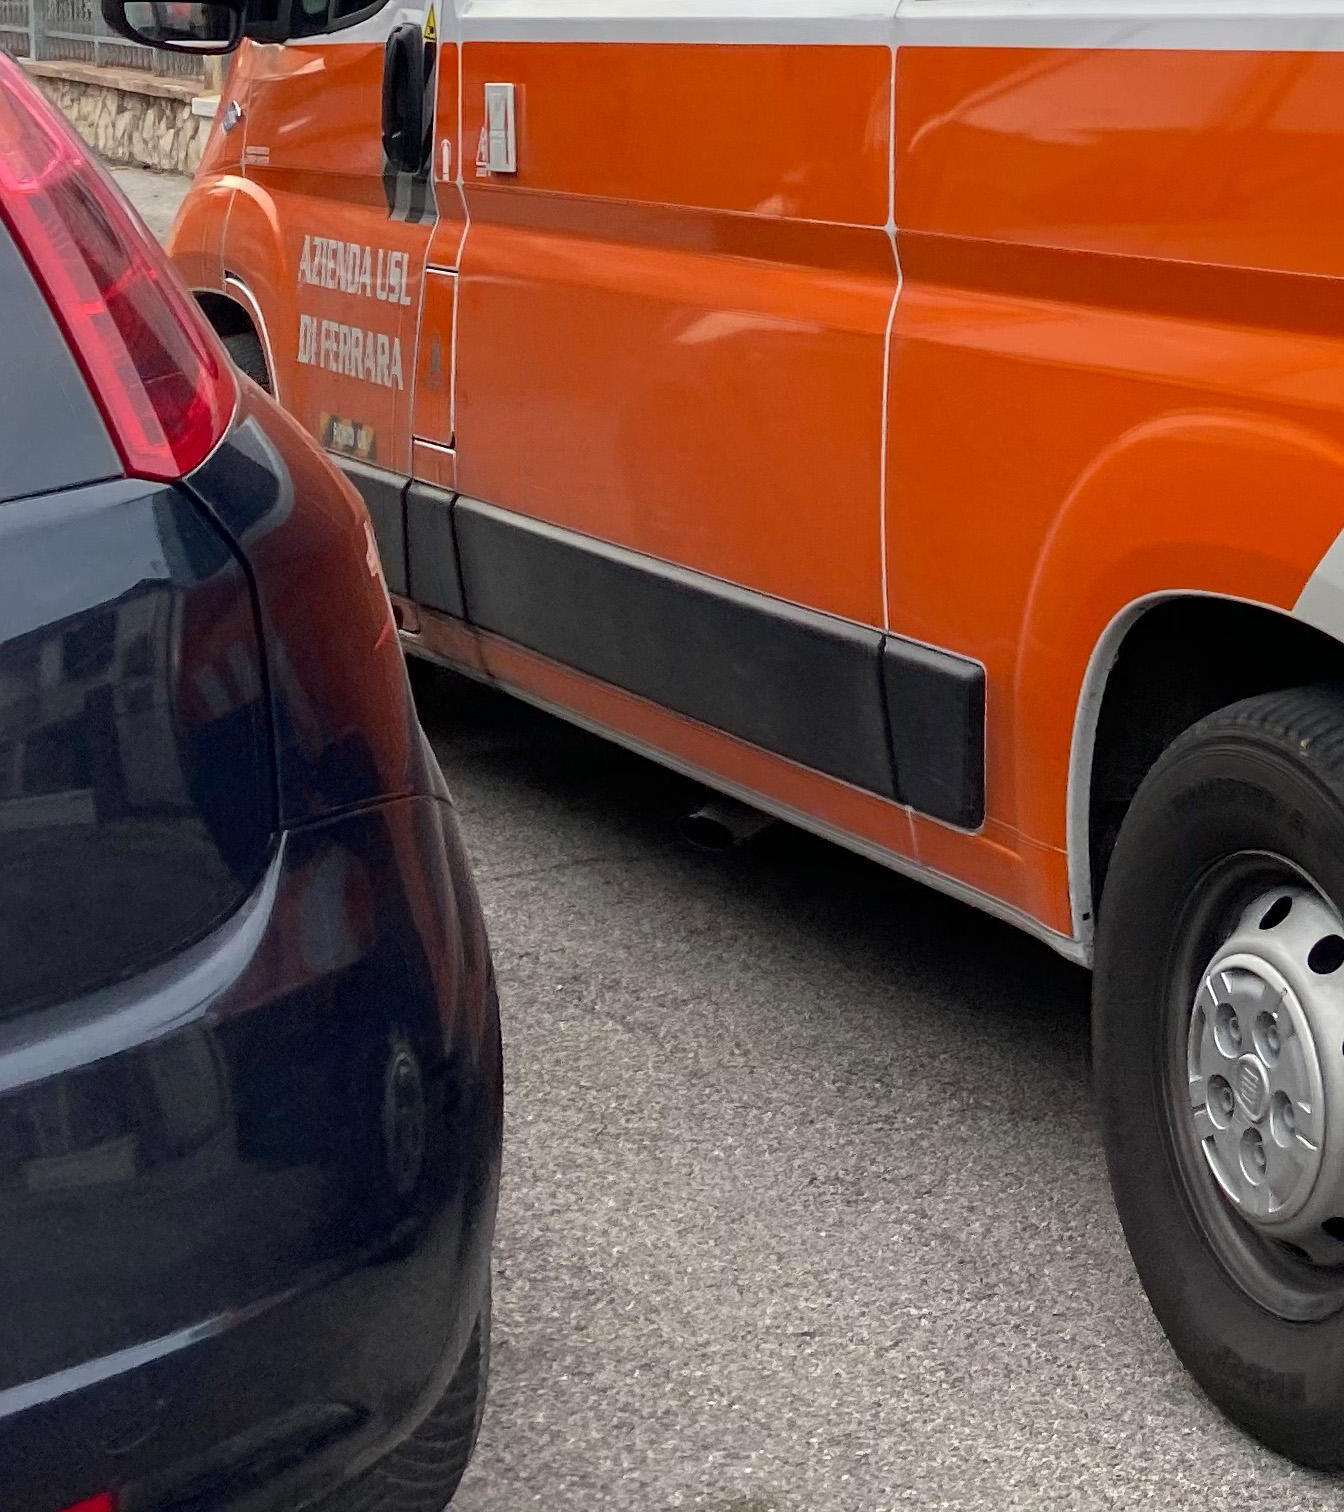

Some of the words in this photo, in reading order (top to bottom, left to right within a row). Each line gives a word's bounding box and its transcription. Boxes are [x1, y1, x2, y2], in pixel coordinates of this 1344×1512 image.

[298, 235, 372, 298] AZIENDA
[376, 248, 412, 307] USL
[297, 314, 318, 366] DI
[319, 319, 404, 391] FERRARA
